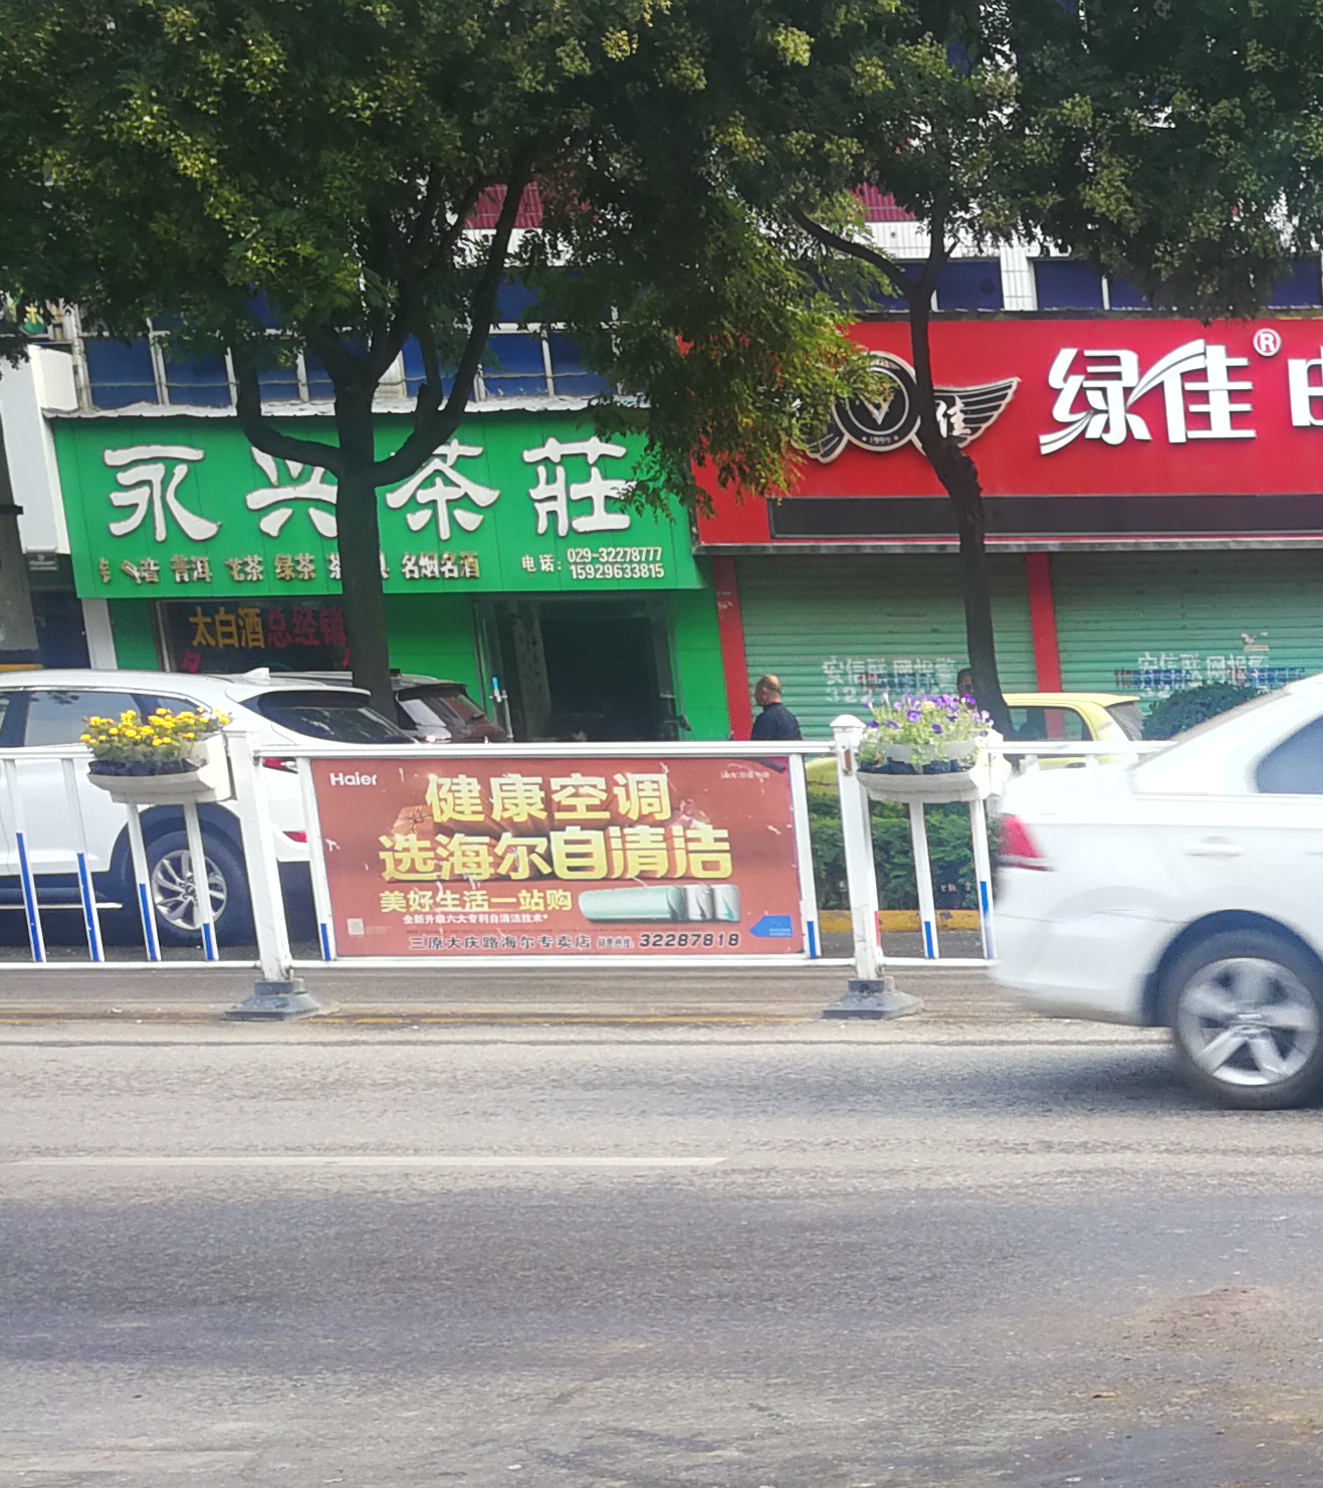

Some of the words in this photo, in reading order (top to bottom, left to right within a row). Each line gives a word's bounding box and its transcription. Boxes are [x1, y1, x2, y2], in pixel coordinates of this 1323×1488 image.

[566, 546, 663, 564] 029-32278777
[274, 553, 317, 582] 绿茶
[402, 552, 481, 581] 名烟名酒
[569, 563, 665, 580] 15929633815
[329, 771, 378, 786] Haier
[425, 772, 673, 824] 健康空调
[378, 824, 734, 882] 选海尔自清洁
[379, 888, 573, 914] 美好生活一站购
[408, 935, 592, 950] 三原大庆路海尔专卖店
[639, 932, 741, 948] 32287818
